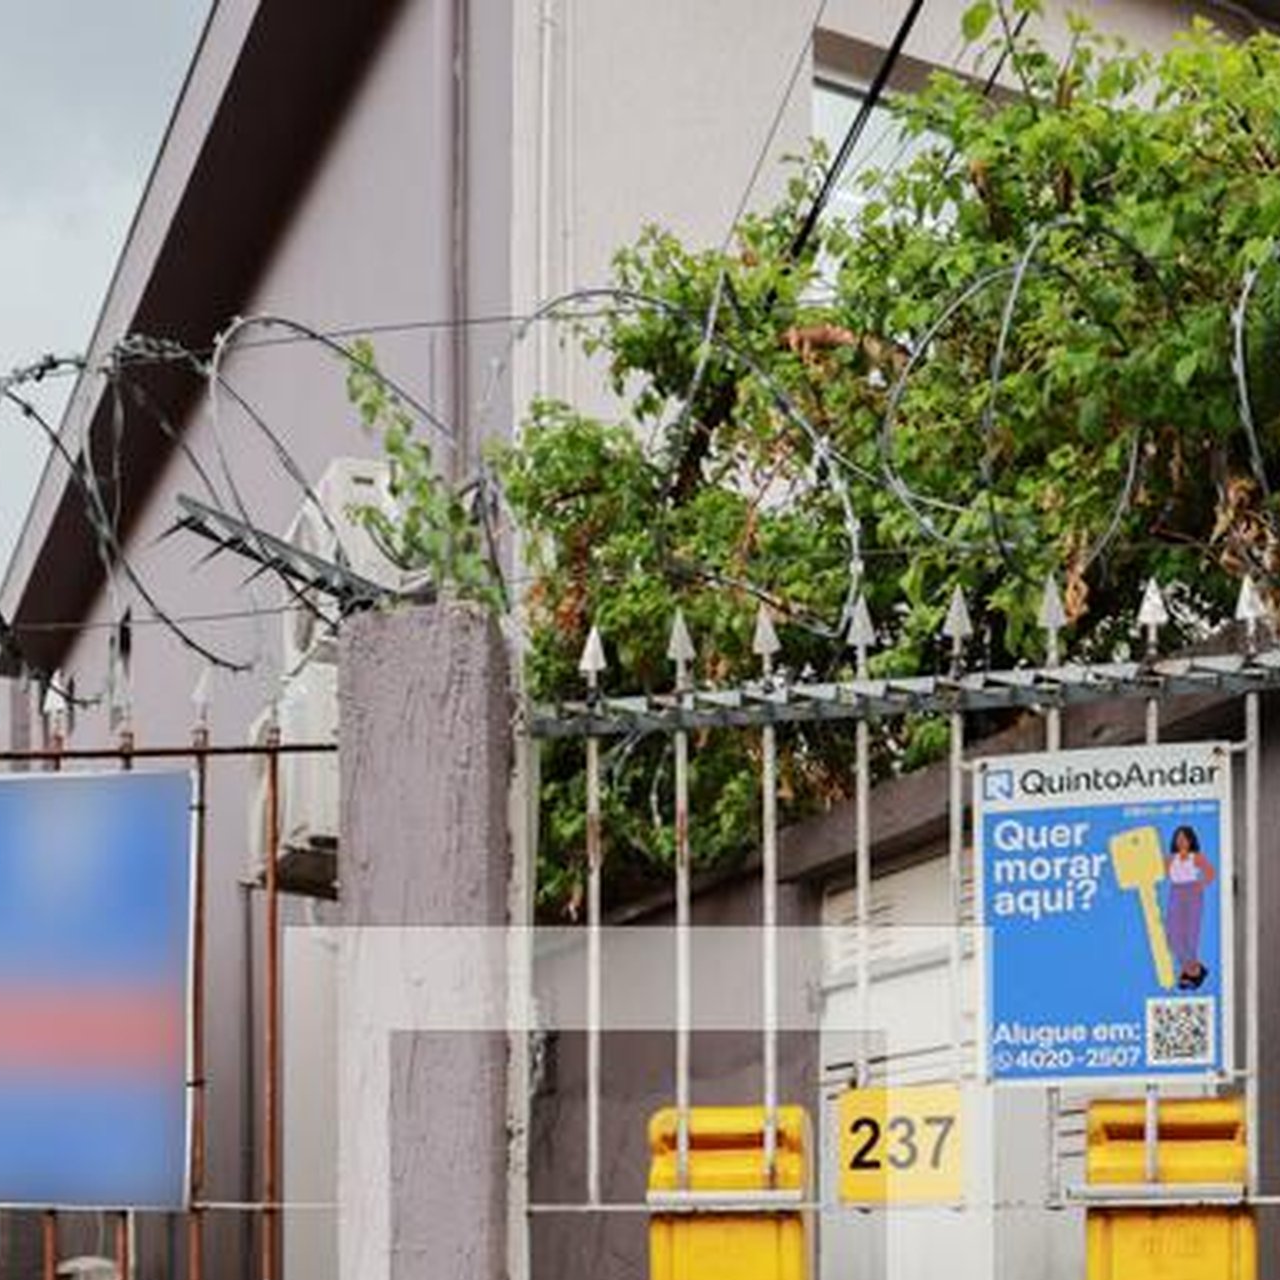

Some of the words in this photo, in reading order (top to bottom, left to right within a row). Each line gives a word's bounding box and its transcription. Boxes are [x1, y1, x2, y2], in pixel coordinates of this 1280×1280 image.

[1020, 760, 1222, 796] QuintoAndar
[993, 820, 1091, 852] Quer
[993, 853, 1108, 883] morar
[993, 880, 1099, 921] aqui?
[993, 1022, 1087, 1048] Alugue
[848, 1115, 956, 1170] 237
